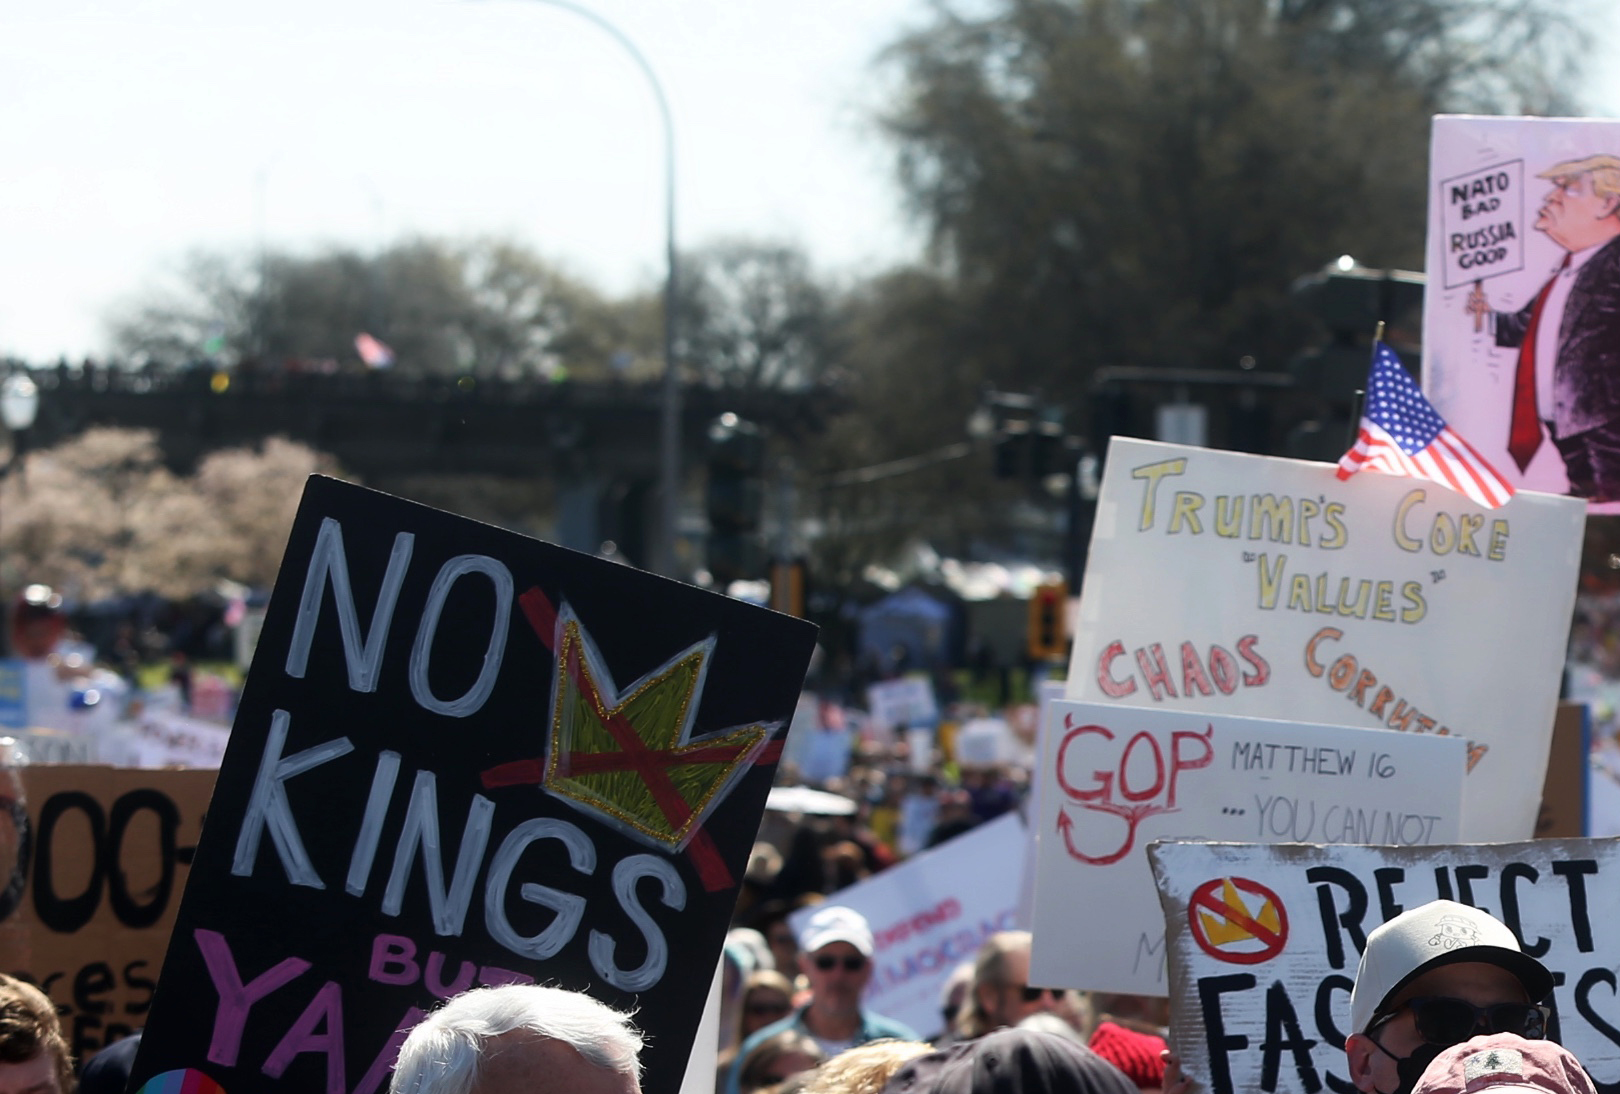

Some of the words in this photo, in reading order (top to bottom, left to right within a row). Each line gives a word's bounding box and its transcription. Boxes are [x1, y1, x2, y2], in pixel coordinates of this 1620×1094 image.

[1451, 171, 1509, 205] NATO
[1461, 197, 1501, 220] BAD
[1450, 221, 1516, 253] RUSSIA
[1132, 457, 1348, 550] TRUMP'S
[285, 516, 514, 718] NO
[1097, 634, 1272, 702] CHAOS
[1056, 715, 1214, 808] GOP
[1232, 741, 1357, 776] MATTHEW
[1368, 752, 1397, 779] 16
[231, 708, 687, 992] KINGS
[1254, 795, 1317, 844] YOU
[1323, 802, 1376, 845] CAN
[1384, 814, 1442, 845] NOT
